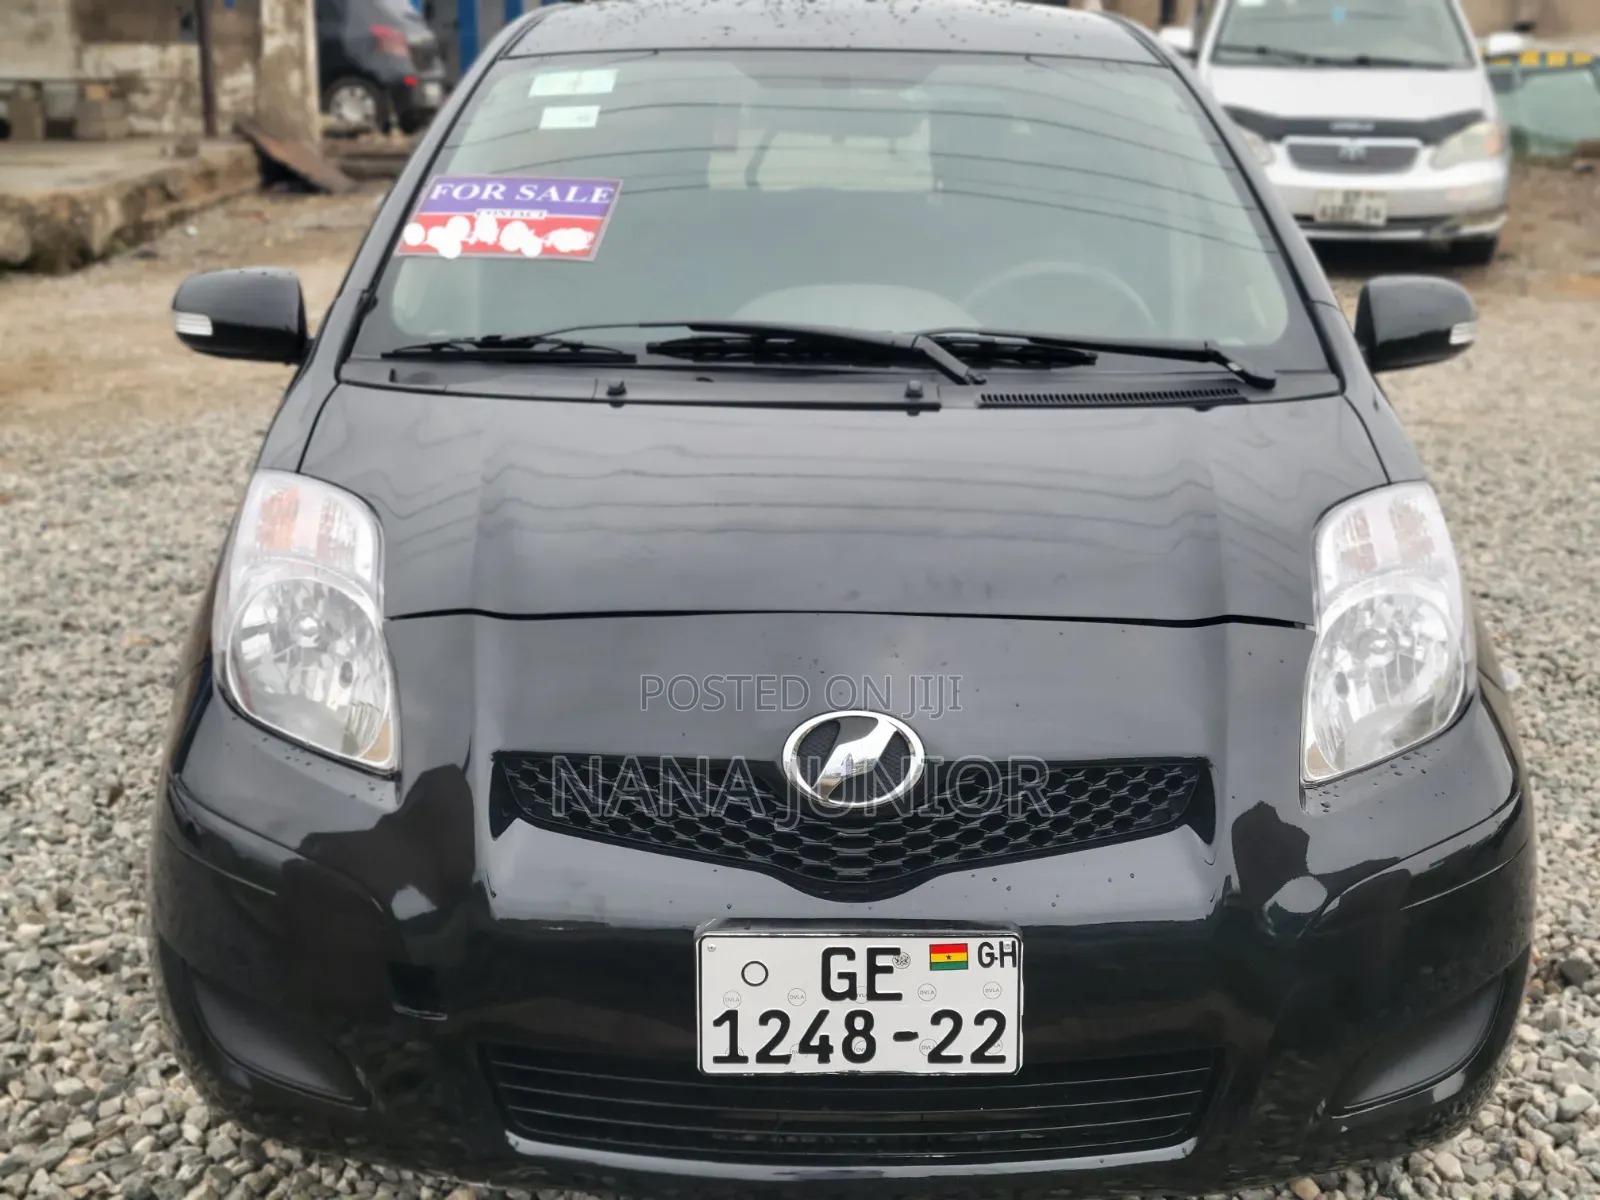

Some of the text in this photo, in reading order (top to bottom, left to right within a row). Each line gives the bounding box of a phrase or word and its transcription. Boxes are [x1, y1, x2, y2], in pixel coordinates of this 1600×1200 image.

[430, 183, 615, 204] FOR SALE
[821, 946, 904, 1001] GE
[712, 1009, 1007, 1065] 1248-22
